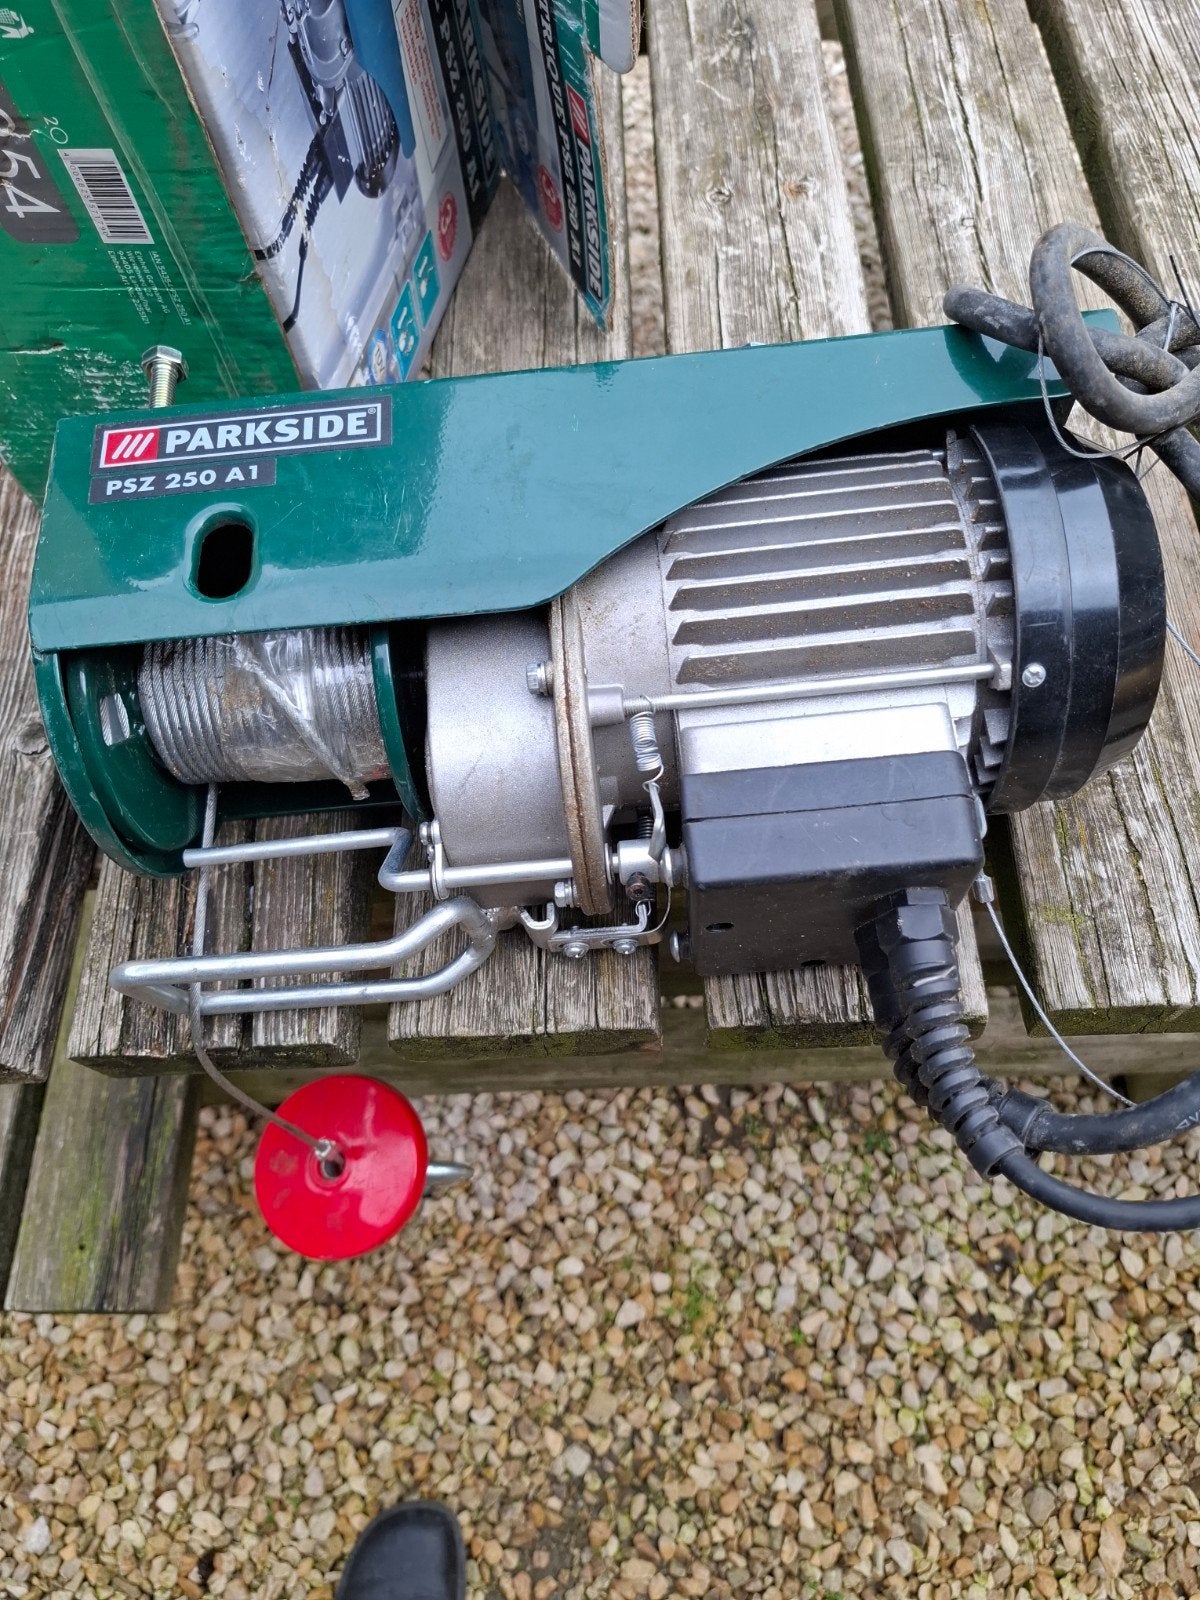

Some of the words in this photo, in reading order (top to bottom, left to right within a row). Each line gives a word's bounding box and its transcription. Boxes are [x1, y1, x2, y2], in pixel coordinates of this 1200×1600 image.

[577, 138, 601, 296] PARKSIDE
[106, 475, 155, 496] PSZ
[165, 469, 217, 490] 250
[225, 464, 259, 483] A1
